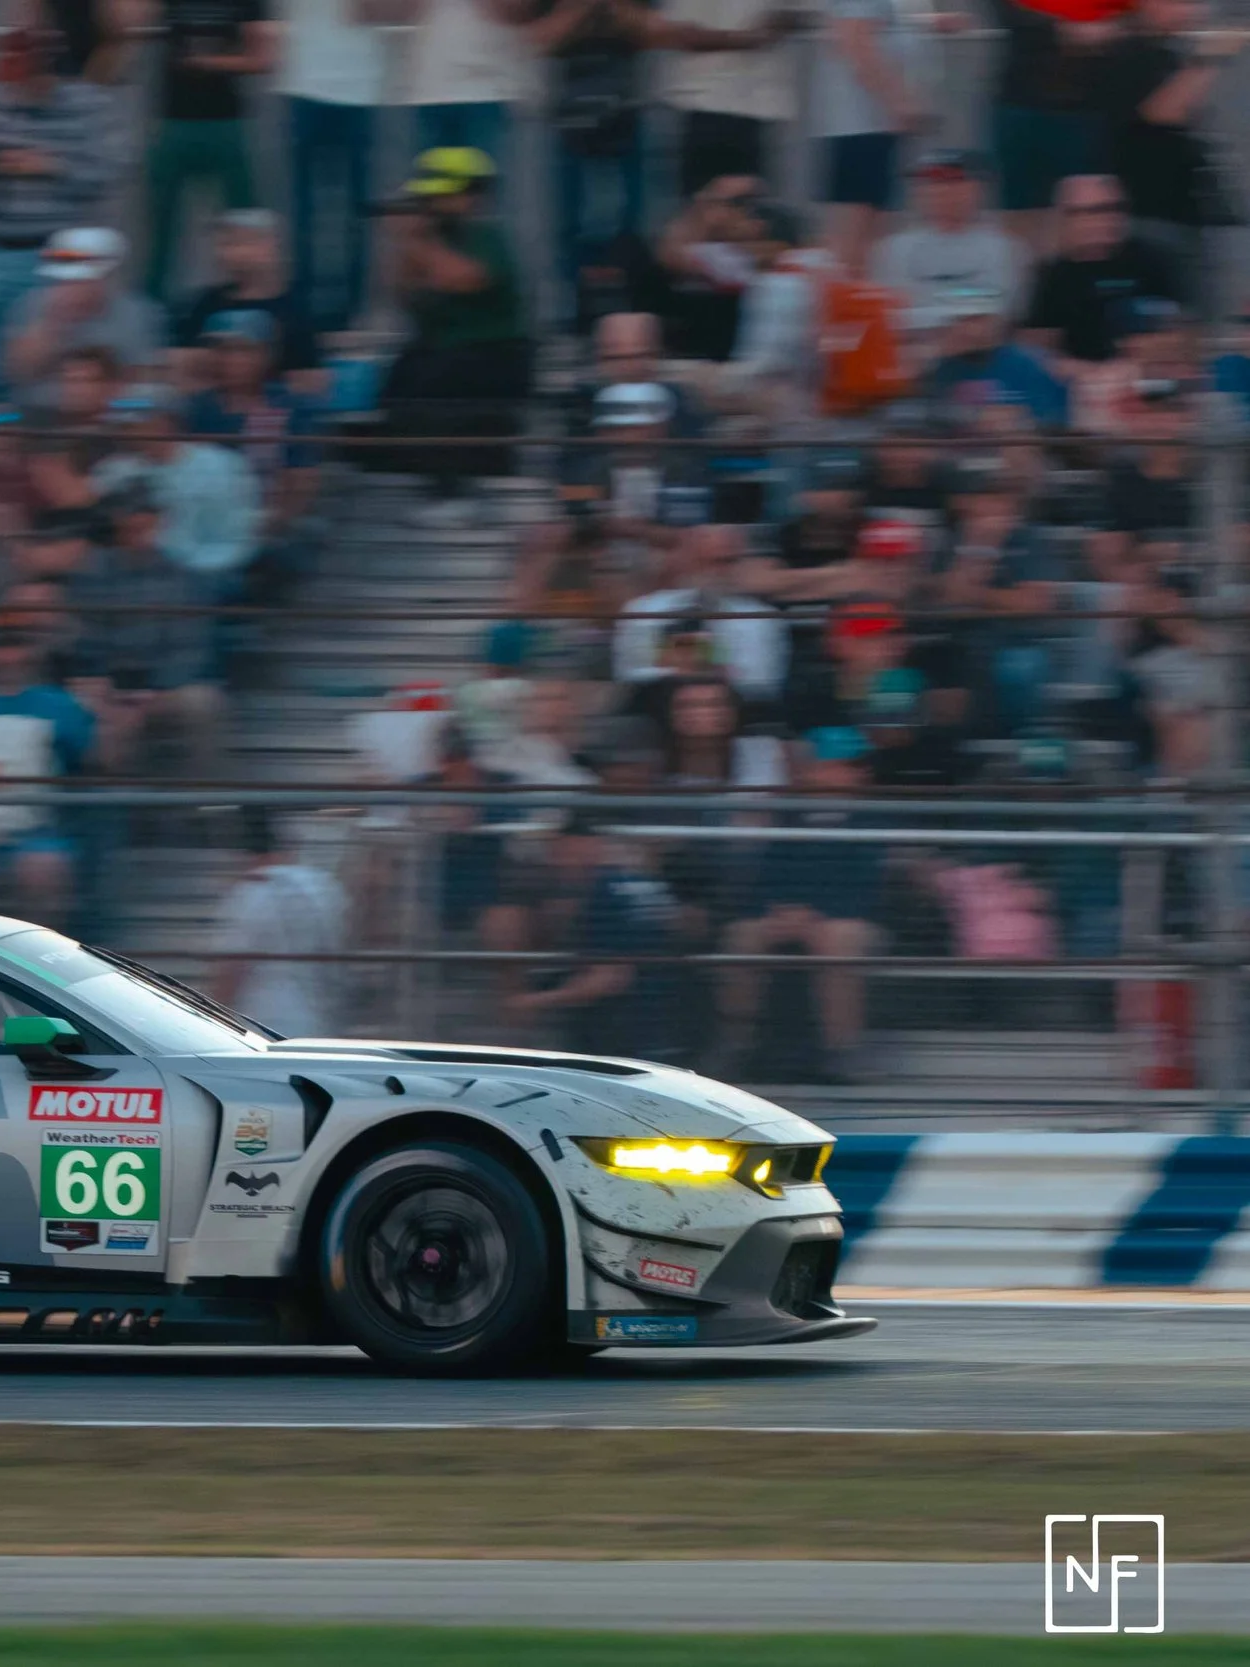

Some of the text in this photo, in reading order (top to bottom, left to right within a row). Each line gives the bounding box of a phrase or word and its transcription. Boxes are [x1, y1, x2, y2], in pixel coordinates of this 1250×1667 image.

[33, 1090, 157, 1119] MOTUL
[47, 1132, 157, 1145] WeatherTech
[55, 1149, 146, 1217] 66
